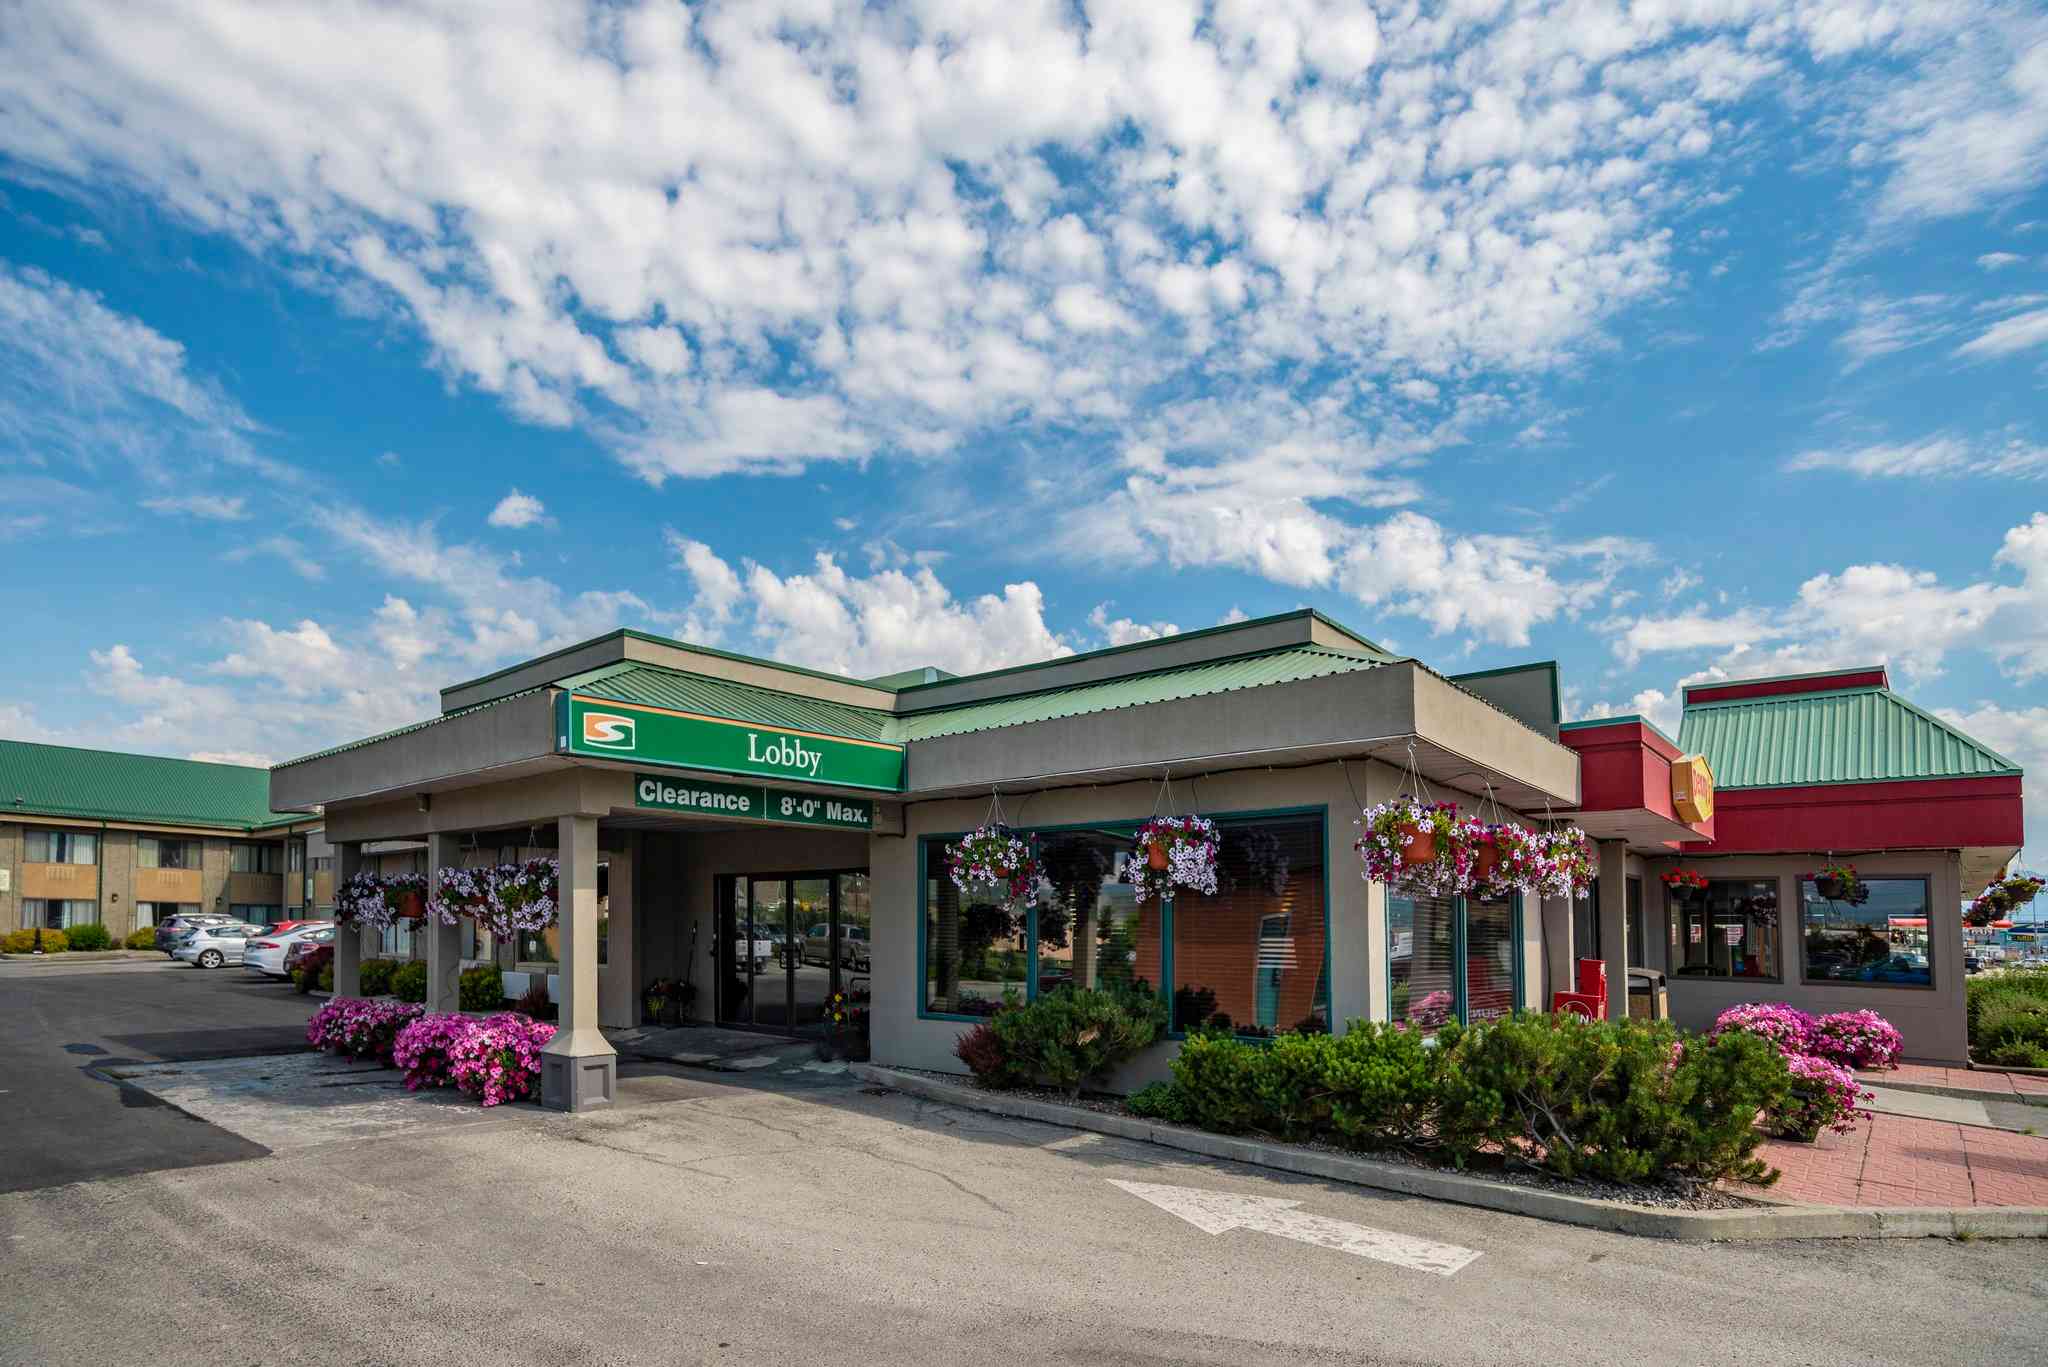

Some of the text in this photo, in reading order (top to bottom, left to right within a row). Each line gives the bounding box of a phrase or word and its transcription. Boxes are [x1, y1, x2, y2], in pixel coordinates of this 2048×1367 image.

[747, 733, 822, 777] Lobby
[639, 780, 750, 811] Clearance
[780, 796, 868, 823] 8'-0" Max.
